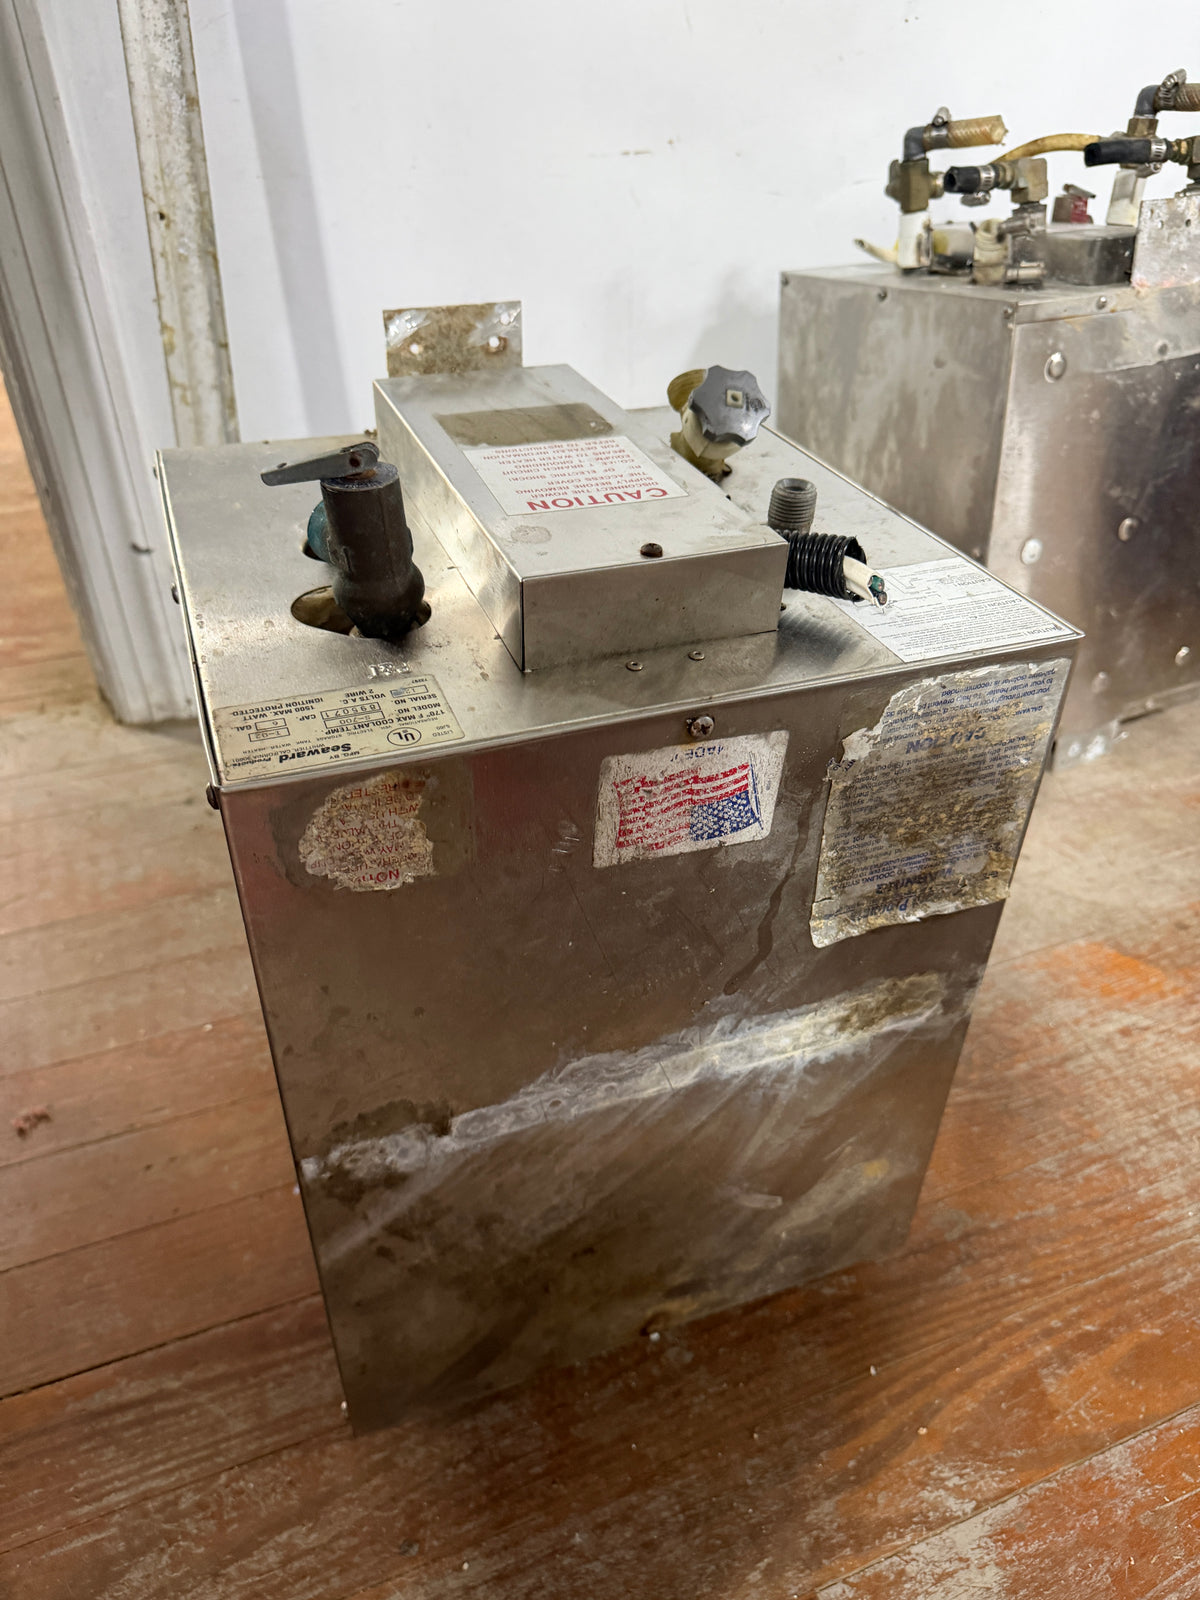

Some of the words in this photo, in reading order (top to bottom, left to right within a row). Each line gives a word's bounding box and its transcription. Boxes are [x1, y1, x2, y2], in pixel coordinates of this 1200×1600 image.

[500, 467, 540, 475] CIRCUIT
[541, 463, 584, 471] BRANCH
[548, 469, 598, 477] ELECTRIC
[614, 476, 654, 484] SUPPLY
[514, 485, 570, 494] REMOVING
[593, 481, 660, 491] DISCONNECT
[524, 487, 671, 510] CAUTION
[1029, 679, 1045, 687] your
[344, 689, 367, 698] WIRE
[357, 692, 385, 701] VOLTS
[407, 693, 437, 702] SERIAL
[284, 696, 323, 708] IGNITION
[410, 701, 441, 711] MODEL
[231, 703, 283, 717] PROTECTED
[293, 704, 314, 712] 1500
[241, 712, 267, 721] WATT
[395, 714, 416, 722] MAX
[352, 718, 394, 729] COOLANT
[392, 729, 415, 743] UL
[431, 729, 454, 737] LISTED
[252, 748, 291, 758] CALIFORNIA
[277, 743, 352, 763] Seaward
[231, 756, 271, 767] Products
